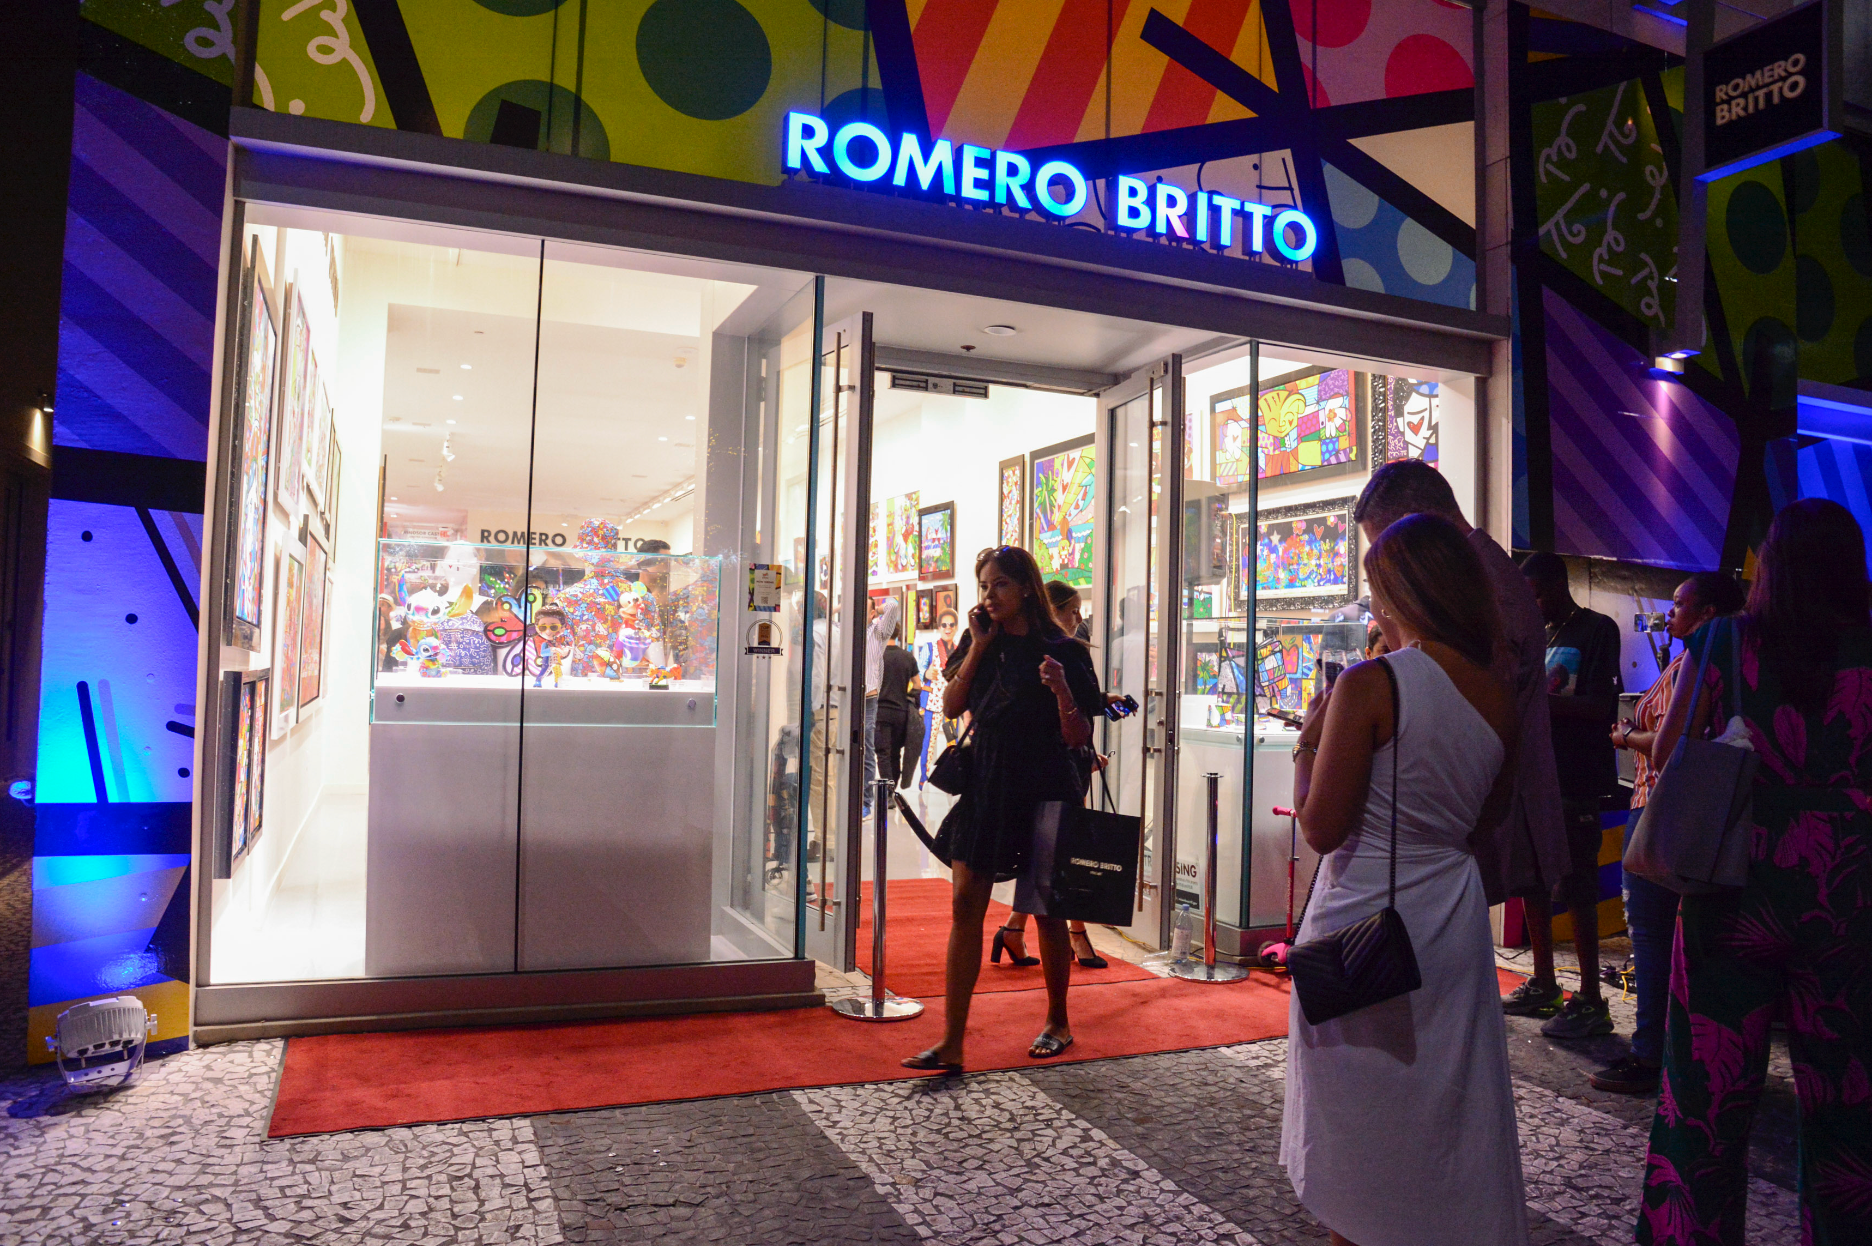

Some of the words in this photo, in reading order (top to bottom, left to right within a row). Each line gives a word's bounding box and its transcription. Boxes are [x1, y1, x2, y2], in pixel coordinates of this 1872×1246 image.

[1715, 53, 1806, 103] ROMERO
[1715, 74, 1806, 126] BRITTO
[786, 111, 1088, 217] ROMERO
[1117, 174, 1317, 262] BRITTO
[480, 528, 567, 547] ROMERO
[1070, 857, 1100, 868] ROMERO
